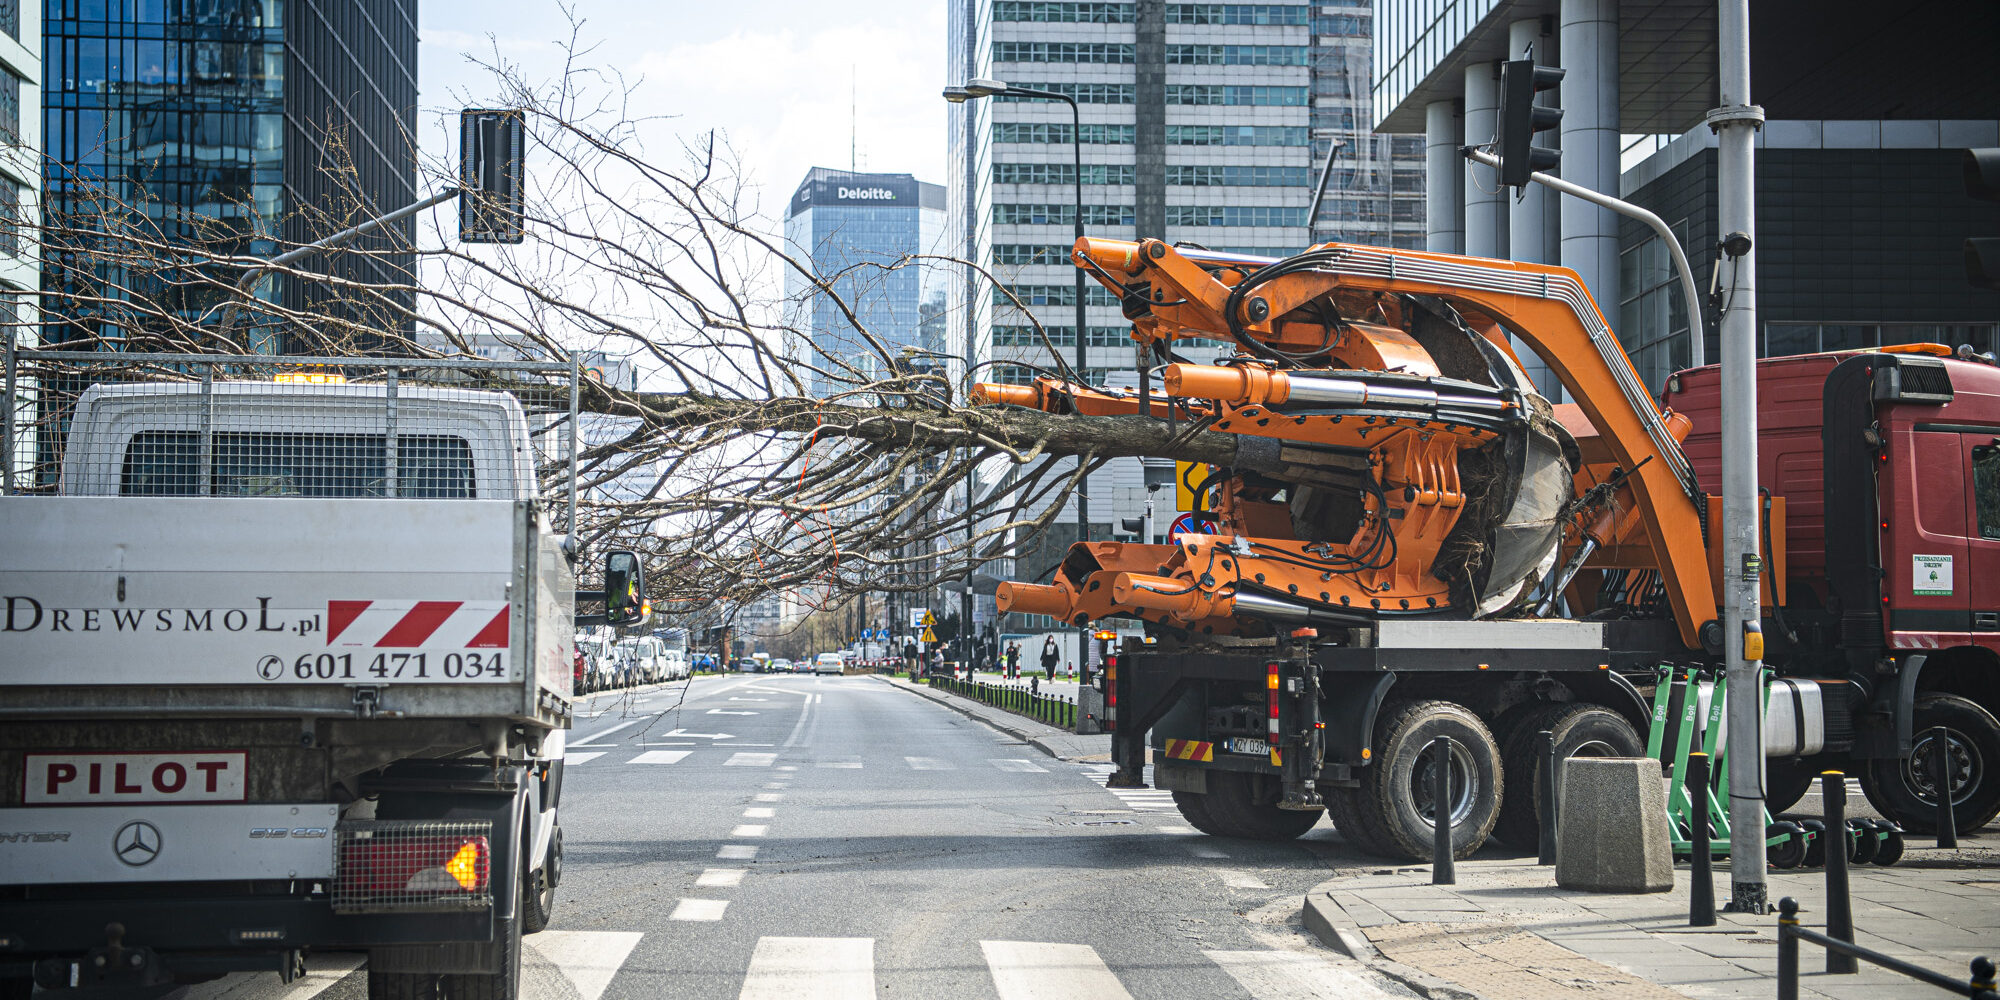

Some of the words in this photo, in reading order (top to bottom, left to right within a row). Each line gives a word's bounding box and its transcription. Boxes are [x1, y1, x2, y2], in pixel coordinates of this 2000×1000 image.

[294, 653, 356, 679] 601
[368, 653, 430, 678] 471
[443, 652, 505, 678] 034
[1655, 704, 1665, 722] Bolt
[1685, 704, 1695, 722] Bolt
[1710, 705, 1721, 722] Bolt
[46, 761, 228, 794] PILOT
[290, 827, 328, 838] CDI
